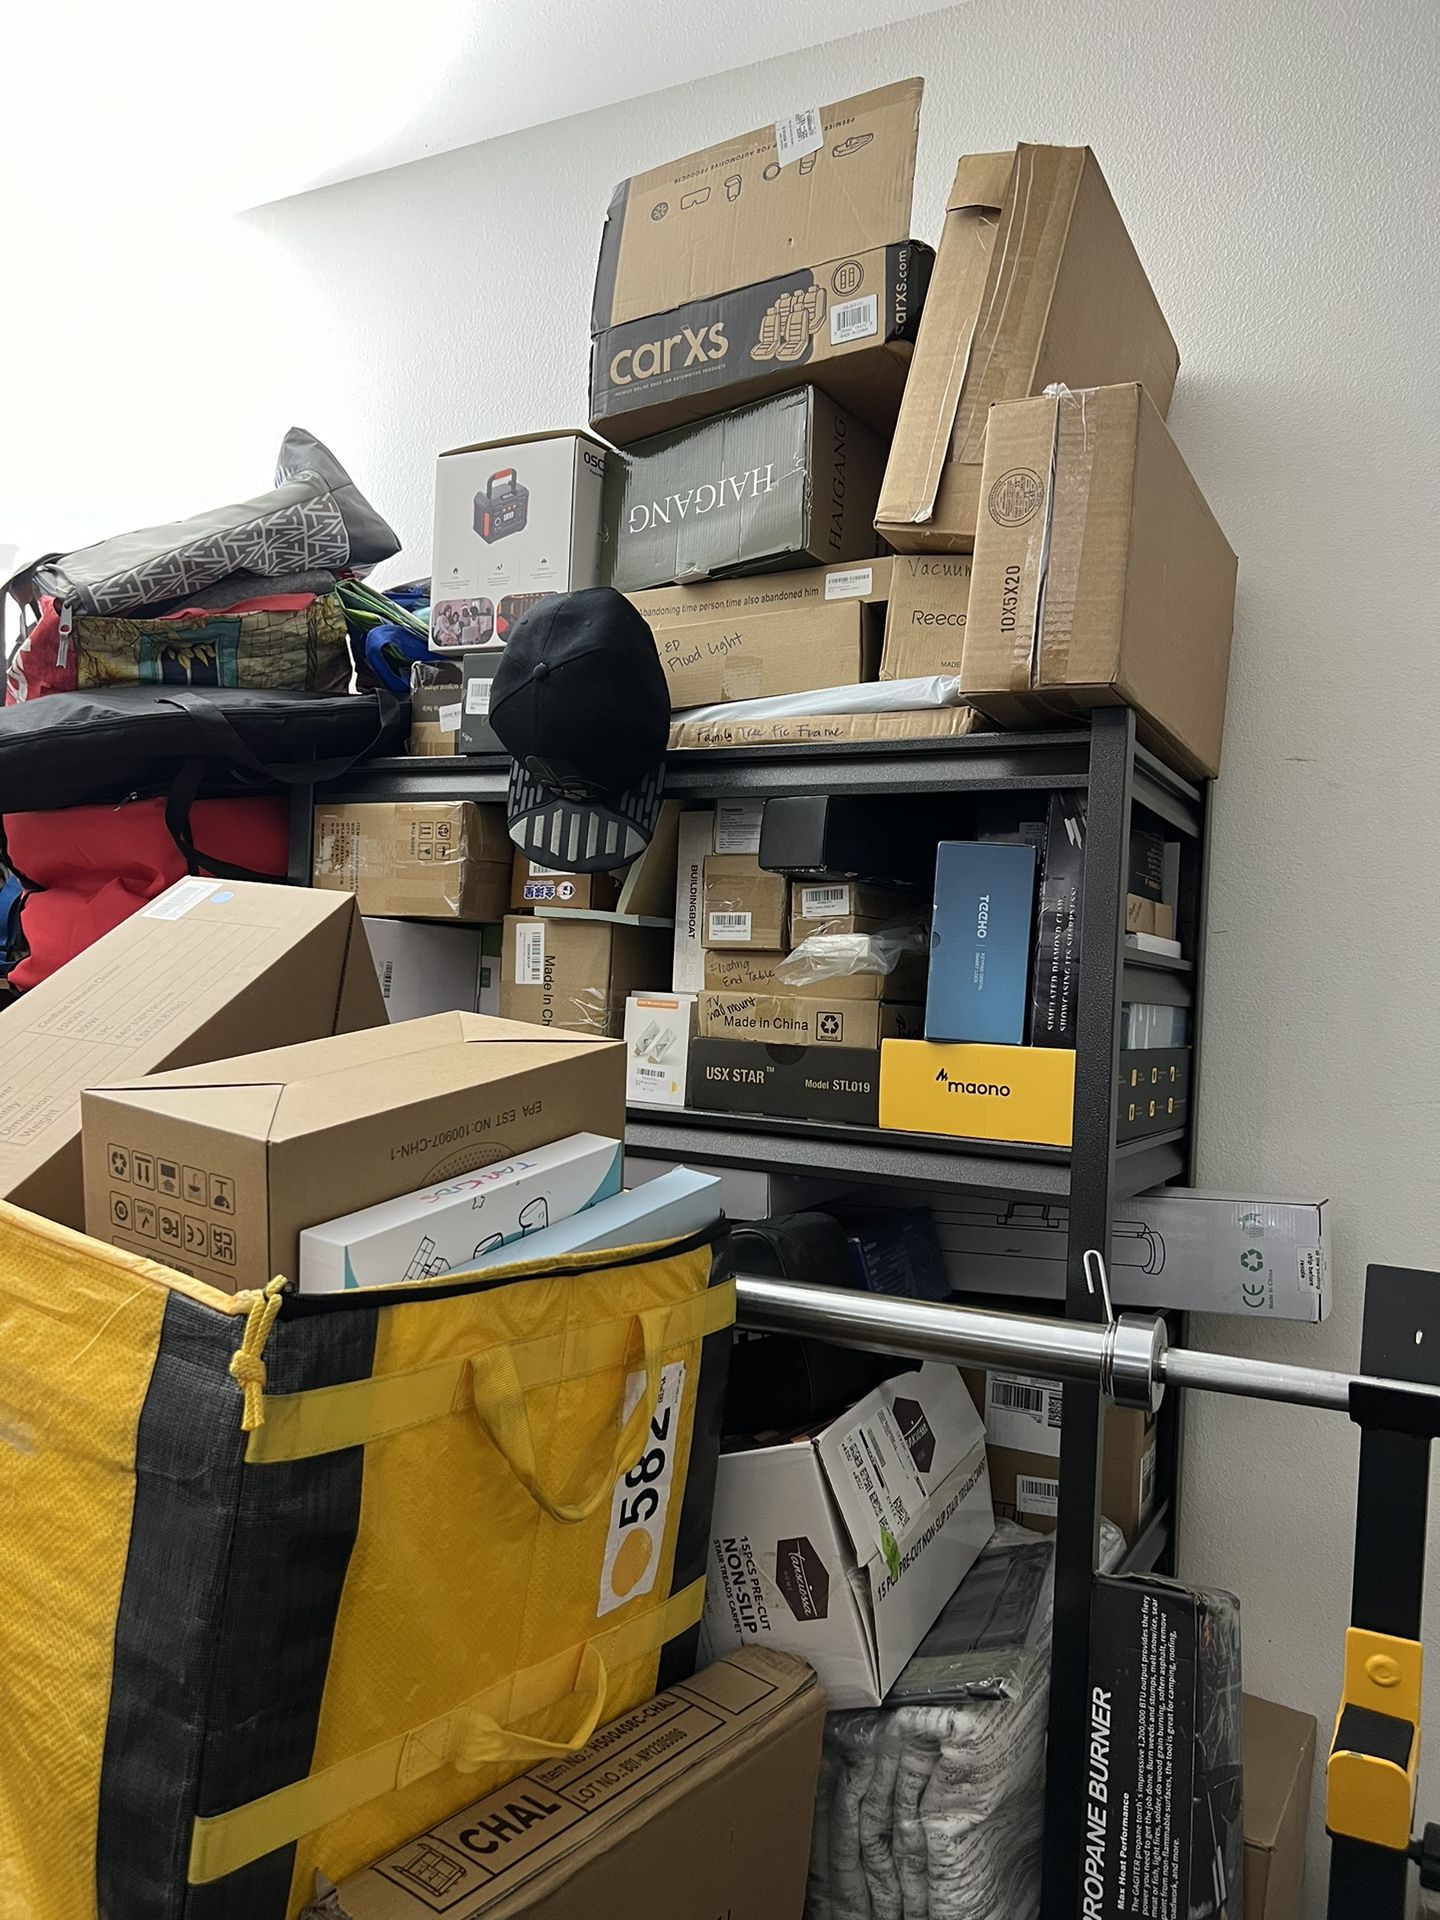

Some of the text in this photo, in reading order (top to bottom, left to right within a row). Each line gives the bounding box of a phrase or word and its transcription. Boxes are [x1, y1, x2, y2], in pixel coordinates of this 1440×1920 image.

[823, 116, 856, 132] PREMIER
[709, 150, 755, 171] AUTOMOTIVE
[673, 167, 709, 184] PRODUCTS
[829, 416, 847, 550] HAIGANG
[628, 463, 774, 534] HAIGANG
[743, 594, 759, 606] also
[760, 588, 803, 604] abandoned
[803, 587, 819, 598] him
[1000, 565, 1021, 634] 10X5X20
[658, 639, 681, 657] ED
[941, 660, 961, 669] MADE
[796, 723, 845, 739] Frame
[688, 864, 699, 940] BUILDINGBOAT
[1052, 926, 1062, 973] DIAMOND
[543, 955, 556, 1005] Made In
[722, 972, 743, 988] End
[1060, 967, 1071, 1031] SHOWCASING
[724, 1015, 809, 1031] Made in China
[706, 1066, 730, 1081] USX
[805, 1078, 871, 1094] Model STL019
[947, 1081, 1011, 1097] maono
[495, 1109, 516, 1127] EST
[522, 1101, 543, 1118] EPA
[19, 1109, 60, 1138] Weight
[877, 1581, 887, 1601] 15
[898, 1543, 923, 1578] PRE-CUT
[920, 1512, 946, 1550] NON-SLIP
[944, 1494, 959, 1523] STAIR
[957, 1476, 974, 1507] TREADS
[973, 1455, 987, 1486] CARPET
[713, 1538, 742, 1634] STAIR TREADS CARPET
[722, 1537, 758, 1634] NON-SLIP
[740, 1535, 771, 1631] 15PCS PRE-CUT
[1150, 1616, 1159, 1653] snow/ice,
[1169, 1630, 1177, 1661] roofing,
[1159, 1643, 1167, 1675] asphalt,
[1149, 1674, 1157, 1705] stumps,
[1158, 1676, 1166, 1701] soften
[1168, 1662, 1177, 1699] camping,
[1166, 1699, 1174, 1712] for
[1157, 1702, 1166, 1736] burning,
[1167, 1712, 1175, 1735] great
[1088, 1686, 1112, 1804] BURNER
[1147, 1722, 1155, 1749] weeds
[1131, 1594, 1151, 1912] The GAGITER propane impressive 1,200,000 BTU output provides the fiery
[1156, 1737, 1165, 1759] grain
[1165, 1743, 1173, 1759] tool
[1146, 1749, 1154, 1770] Burn
[1165, 1760, 1173, 1774] the
[536, 1763, 572, 1785] Item
[1155, 1760, 1163, 1783] wood
[571, 1781, 601, 1804] LOT
[1145, 1772, 1153, 1794] done.
[1155, 1784, 1162, 1795] do
[1164, 1776, 1173, 1812] surfaces,
[1145, 1795, 1154, 1810] job
[1154, 1797, 1163, 1824] solder,
[459, 1792, 563, 1856] CHAL
[1145, 1825, 1153, 1839] get
[1145, 1839, 1151, 1848] to
[1153, 1825, 1162, 1846] fires,
[1162, 1812, 1171, 1875] non-flammable
[1117, 1792, 1130, 1910] Max Heat Performance
[1152, 1846, 1161, 1865] light
[1143, 1872, 1151, 1888] you
[1151, 1866, 1160, 1884] fish,
[1152, 1885, 1158, 1896] or
[1161, 1876, 1169, 1898] from
[1142, 1889, 1150, 1916] power
[1160, 1898, 1168, 1920] paint
